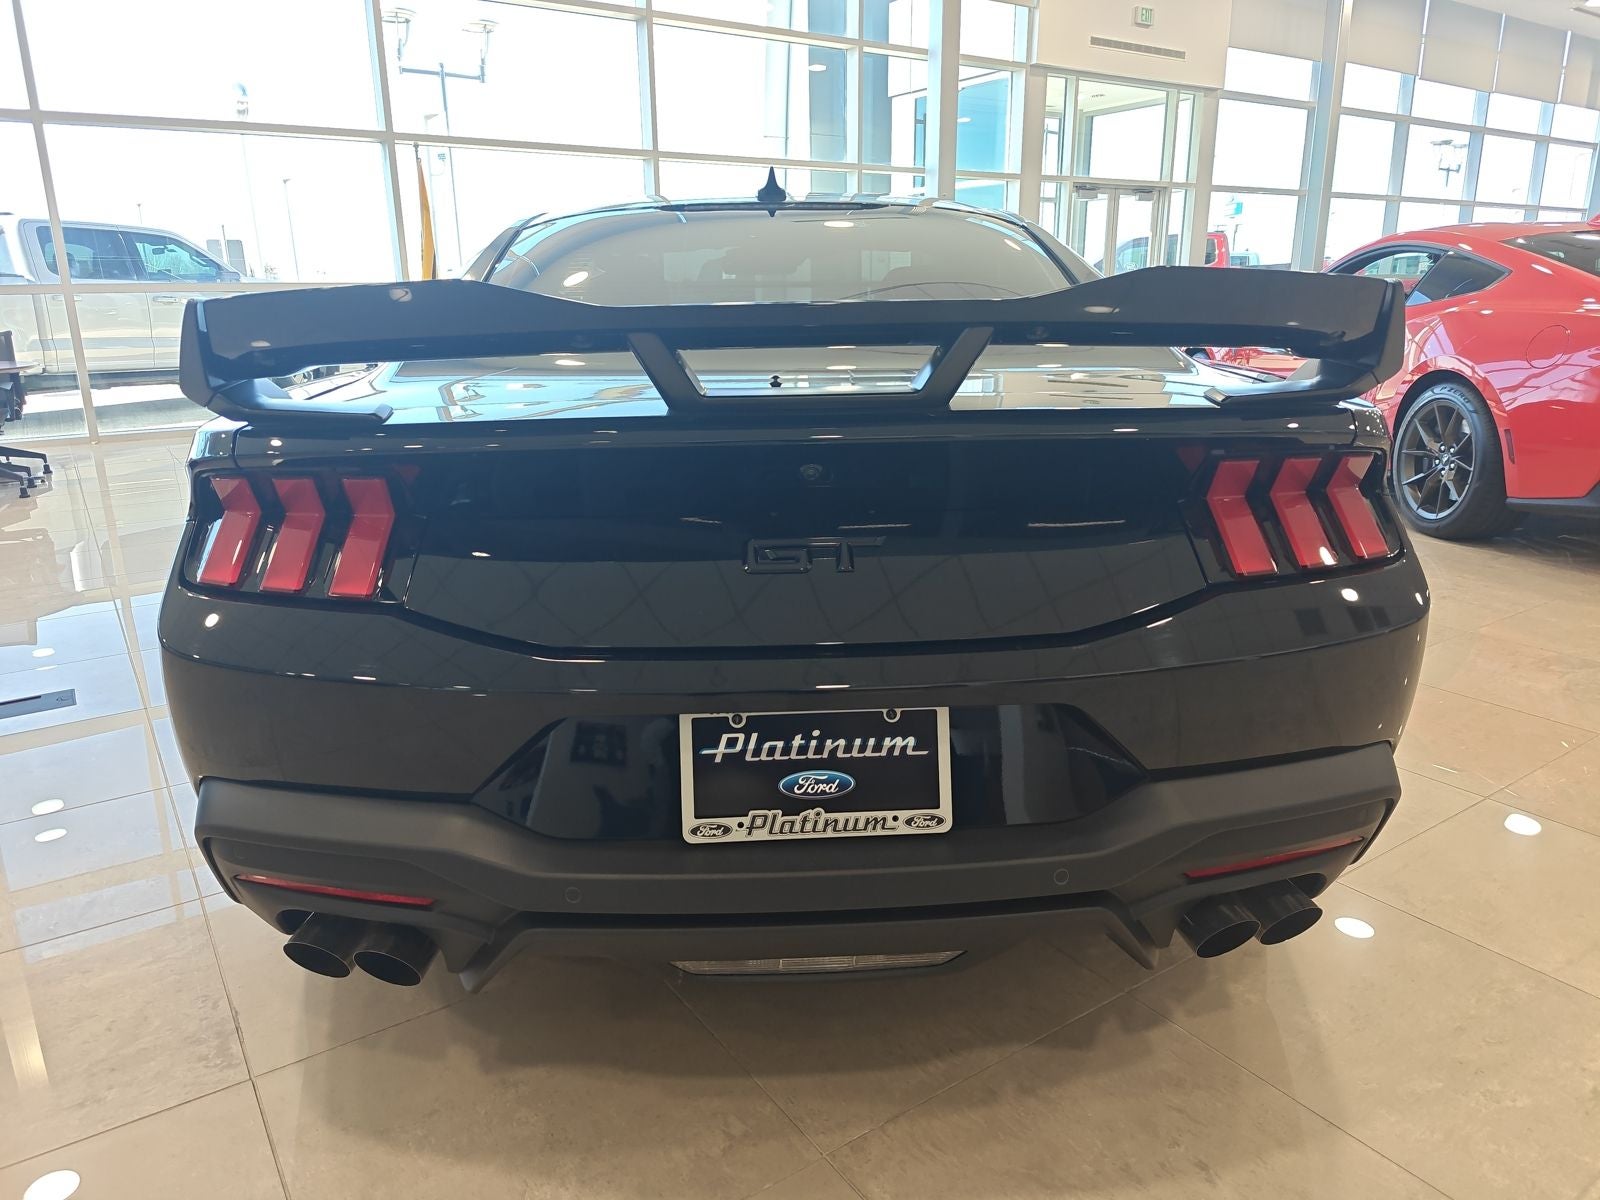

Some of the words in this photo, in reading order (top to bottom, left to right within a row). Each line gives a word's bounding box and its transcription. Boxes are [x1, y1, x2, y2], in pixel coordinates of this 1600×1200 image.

[1140, 7, 1153, 23] EXIT
[1447, 387, 1471, 404] ZERO
[743, 536, 887, 574] GT
[700, 729, 929, 763] Platinum
[793, 774, 840, 795] Ford
[696, 824, 724, 838] Ford
[744, 809, 898, 837] Platinum
[910, 814, 938, 829] Ford
